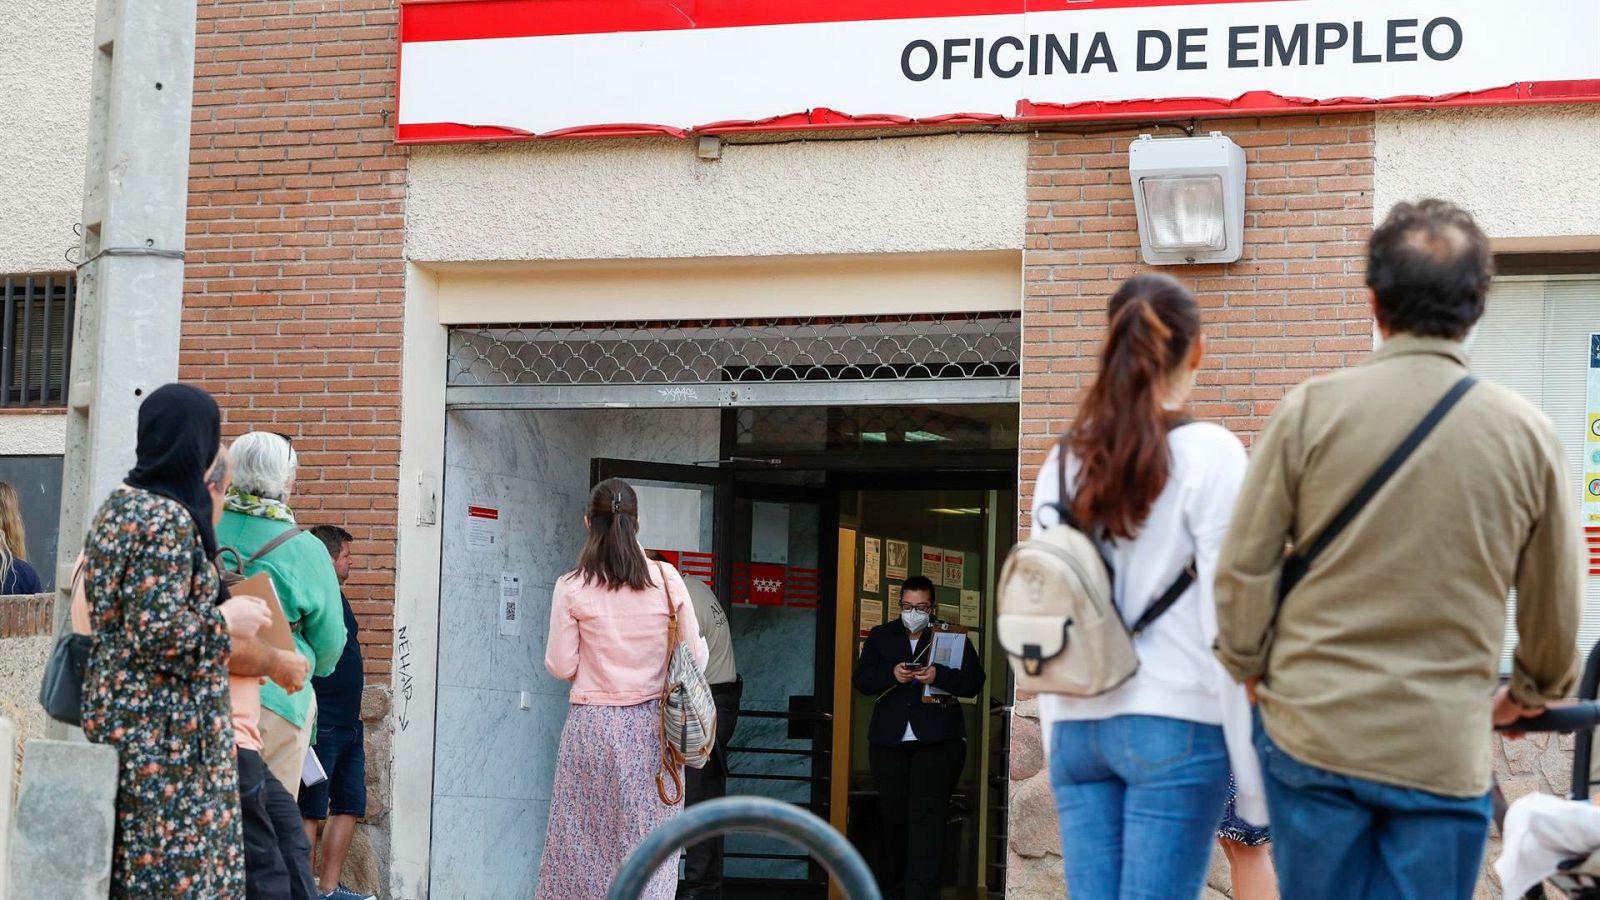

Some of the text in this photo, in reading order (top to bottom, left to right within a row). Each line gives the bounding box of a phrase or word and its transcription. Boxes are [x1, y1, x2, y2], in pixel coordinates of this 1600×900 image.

[900, 16, 1463, 82] OFICINA DE EMPLEO
